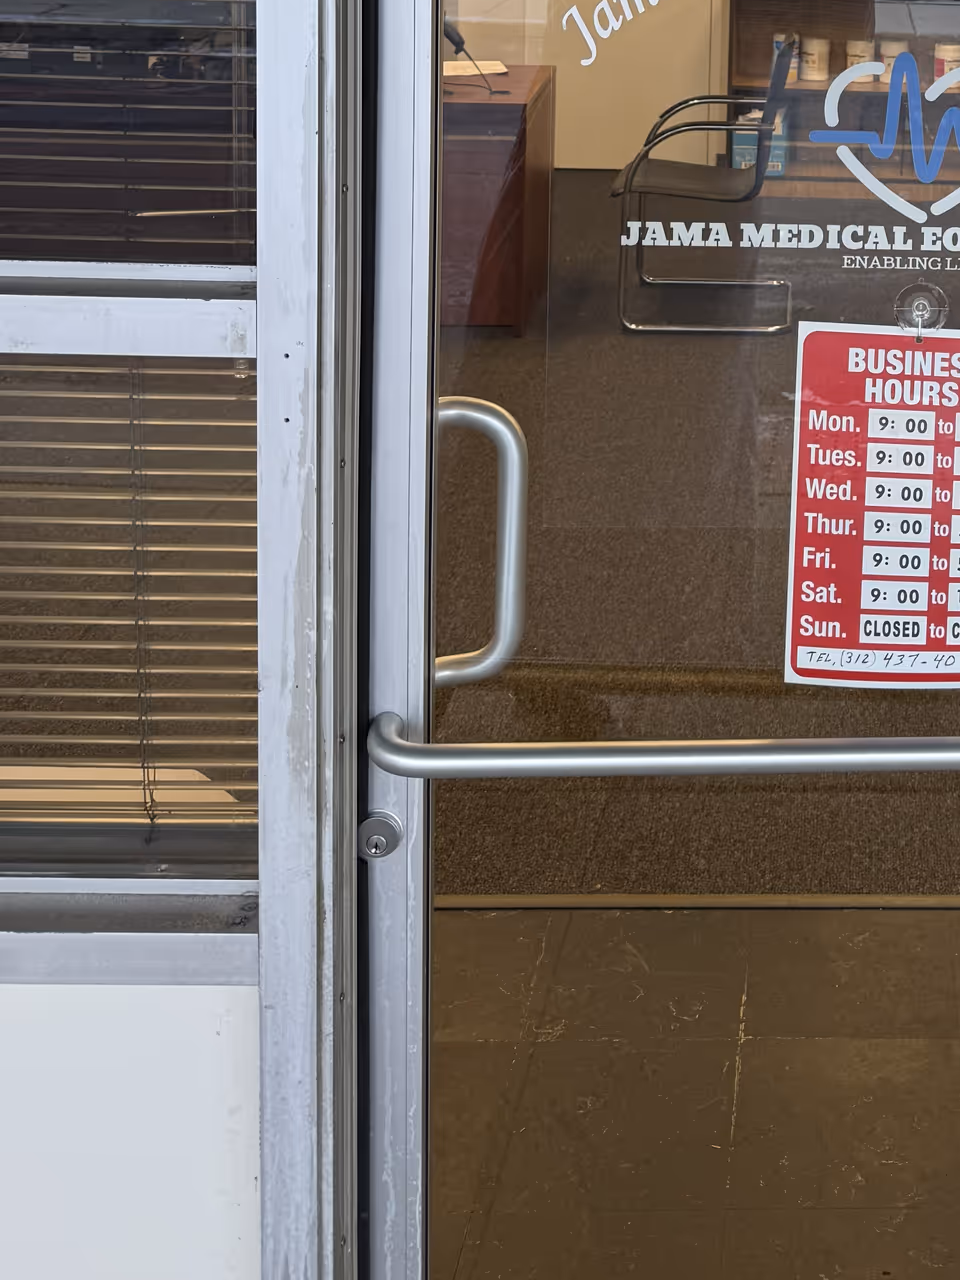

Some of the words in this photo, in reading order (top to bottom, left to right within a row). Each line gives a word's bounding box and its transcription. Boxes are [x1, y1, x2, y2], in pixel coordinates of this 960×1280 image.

[620, 221, 733, 248] JAMA
[739, 223, 913, 251] MEDICAL
[842, 255, 941, 271] ENABLING
[809, 410, 860, 433] Mon.
[938, 418, 953, 435] to
[807, 444, 861, 467] Tues.
[937, 453, 952, 468] to
[805, 478, 857, 501] Wed.
[935, 487, 950, 503] to
[804, 512, 856, 536] Thur.
[934, 521, 949, 537] to
[802, 547, 836, 569] Fri.
[932, 556, 948, 572] to
[801, 581, 842, 603] Sat.
[931, 589, 946, 605] to
[800, 616, 847, 638] Sun.
[864, 619, 920, 637] CLOSED
[929, 624, 945, 639] to
[840, 650, 876, 668] (312)
